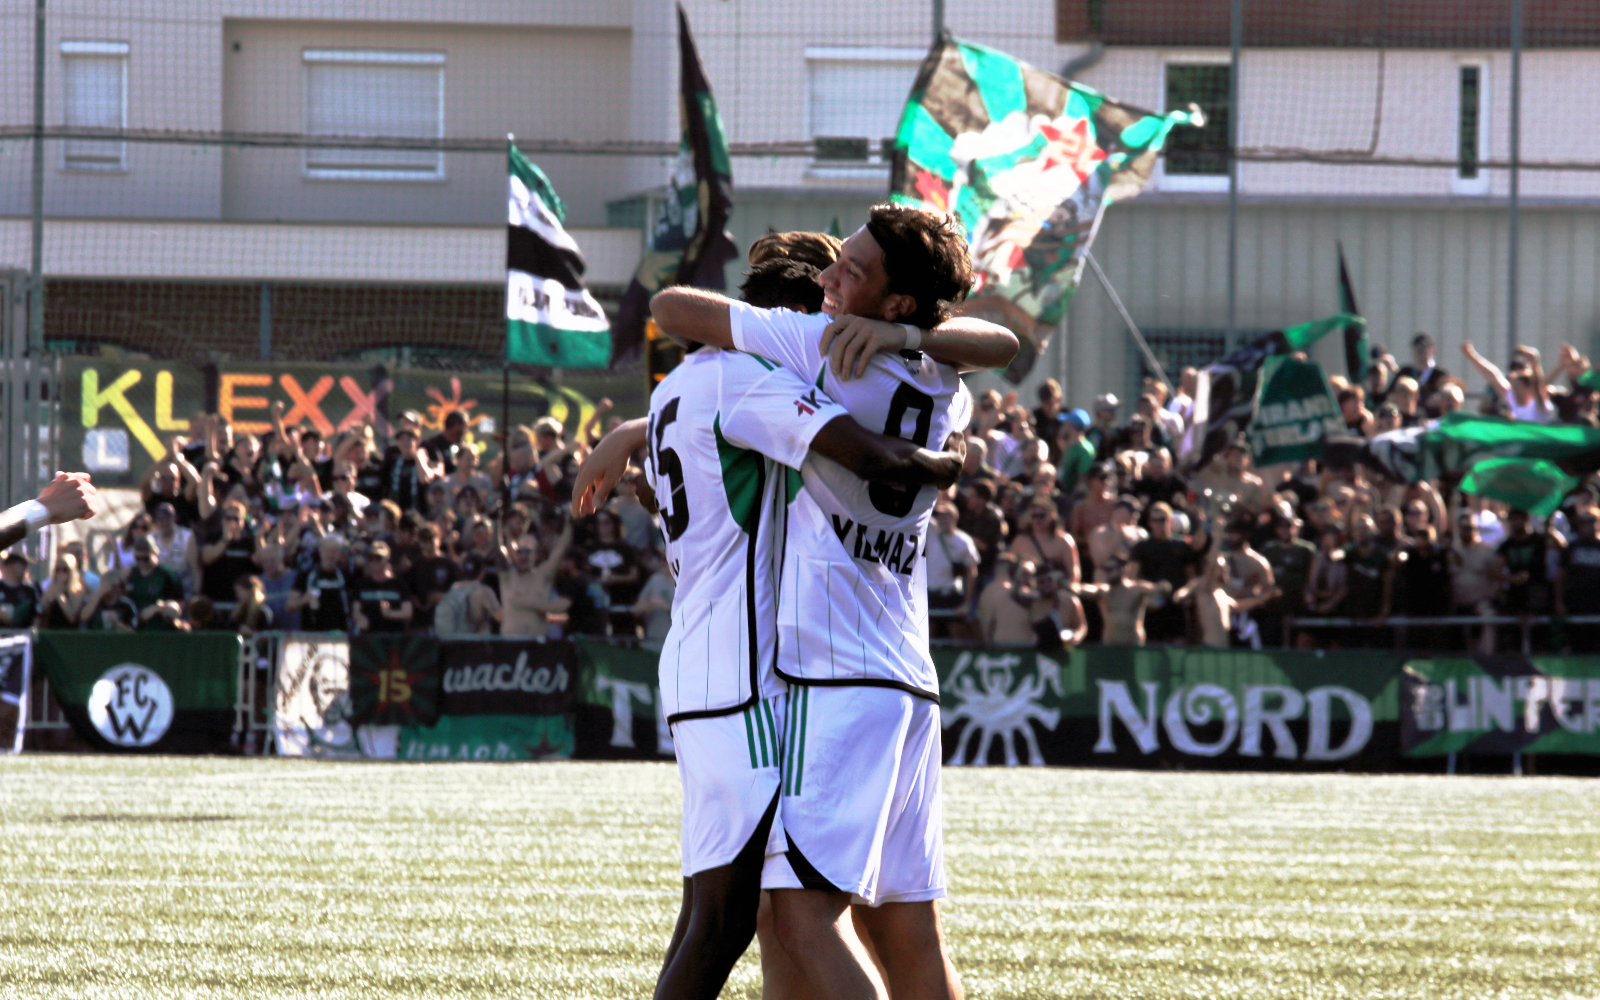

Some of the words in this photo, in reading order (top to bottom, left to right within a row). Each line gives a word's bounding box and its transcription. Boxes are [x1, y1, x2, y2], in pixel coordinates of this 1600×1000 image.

[81, 367, 394, 462] KLEXX
[831, 513, 919, 576] YILMAZ
[115, 671, 149, 708] FC
[377, 668, 412, 702] 15
[443, 650, 570, 695] wacker
[105, 697, 158, 741] W
[1093, 678, 1374, 762] NORD
